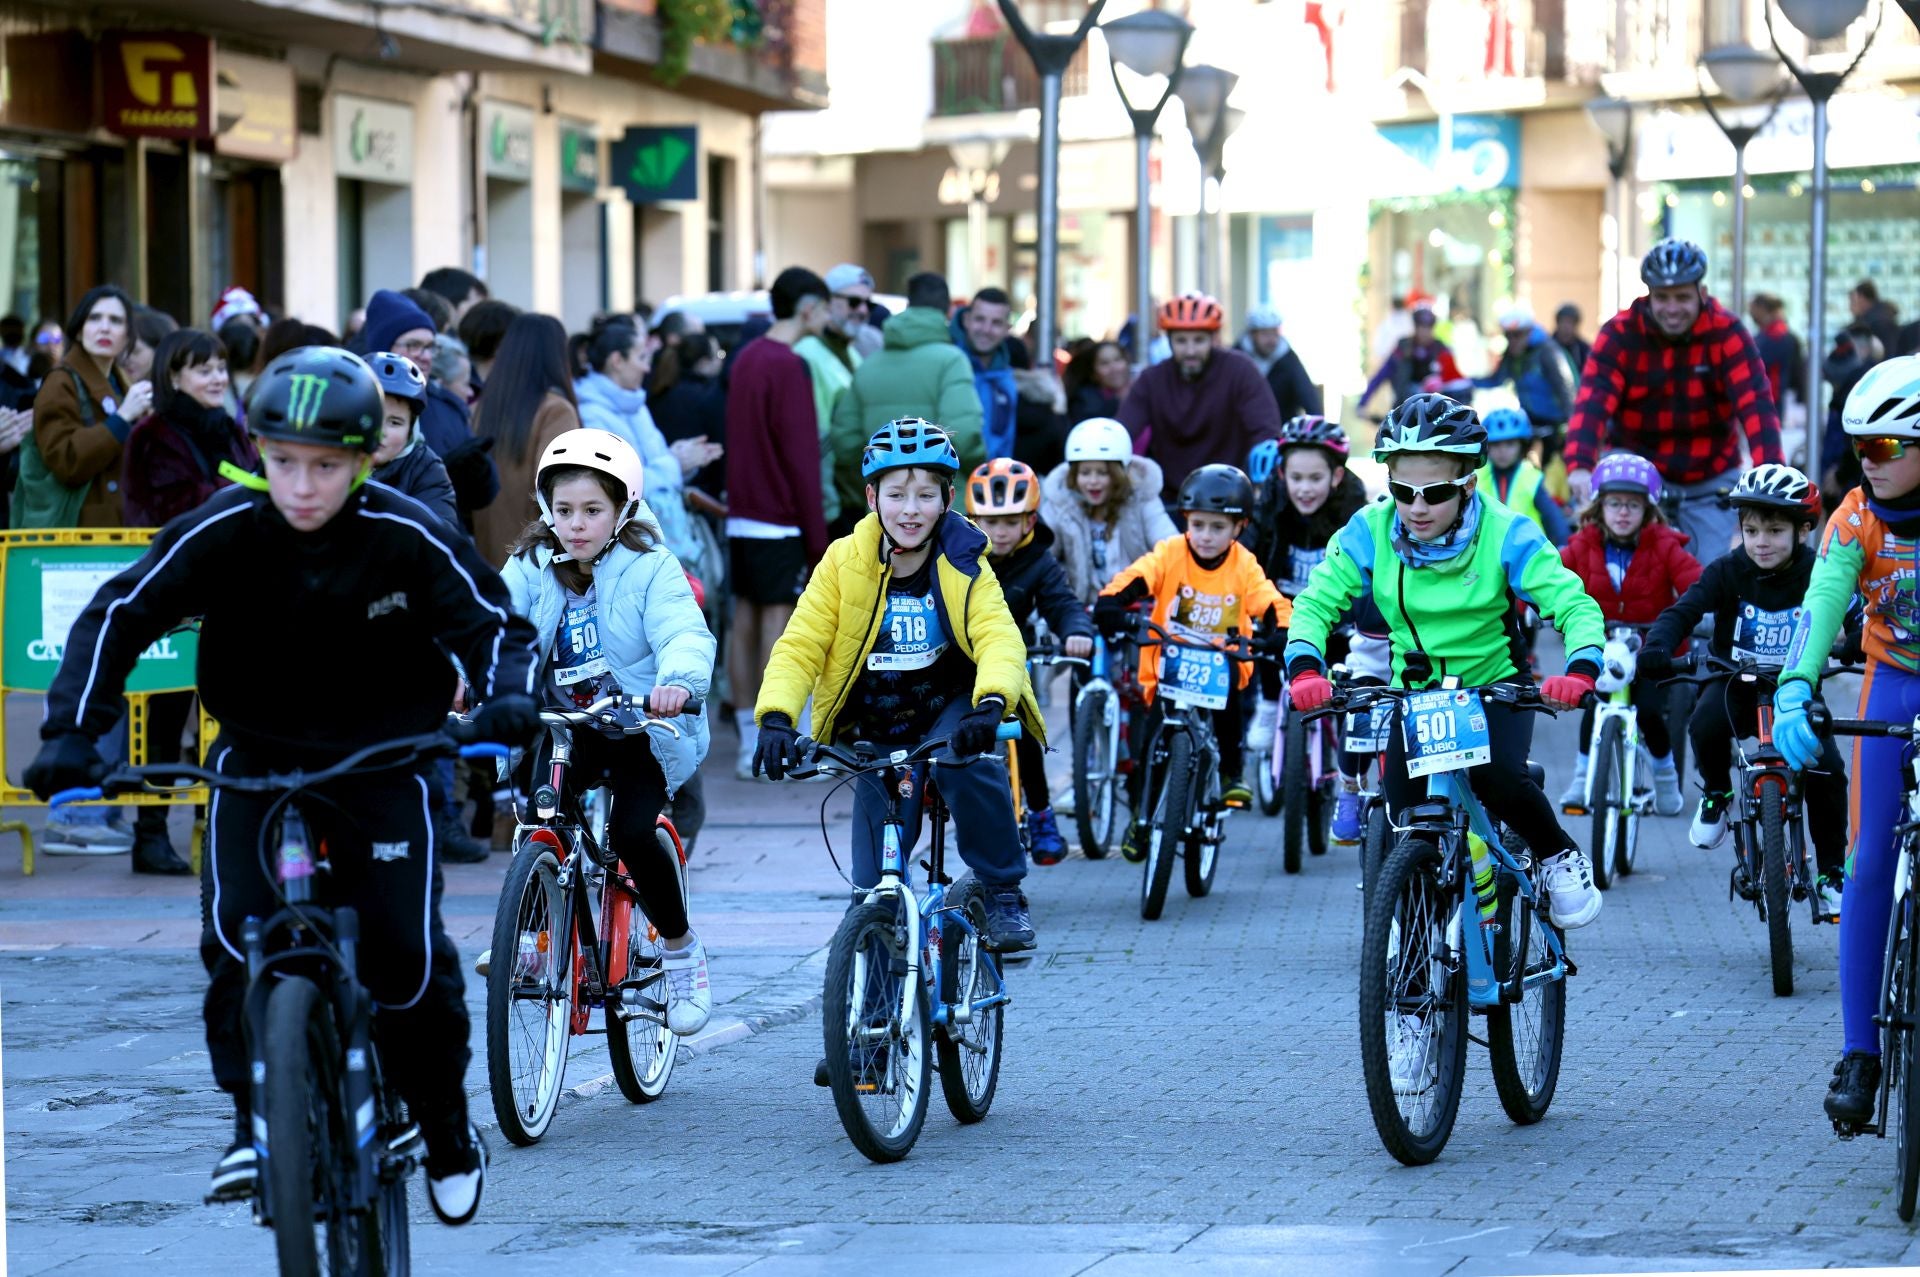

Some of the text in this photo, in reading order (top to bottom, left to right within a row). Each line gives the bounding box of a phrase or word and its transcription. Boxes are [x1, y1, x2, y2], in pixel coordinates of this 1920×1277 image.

[119, 109, 197, 128] TABACOS
[1189, 604, 1222, 626] 339
[571, 622, 598, 654] 50
[891, 616, 927, 642] 518
[1754, 625, 1791, 647] 350
[894, 643, 929, 653] PEDRO
[1755, 646, 1789, 655] MARCO
[1177, 661, 1211, 686] 523
[1416, 710, 1456, 744] 501
[1422, 740, 1457, 755] RUBIO
